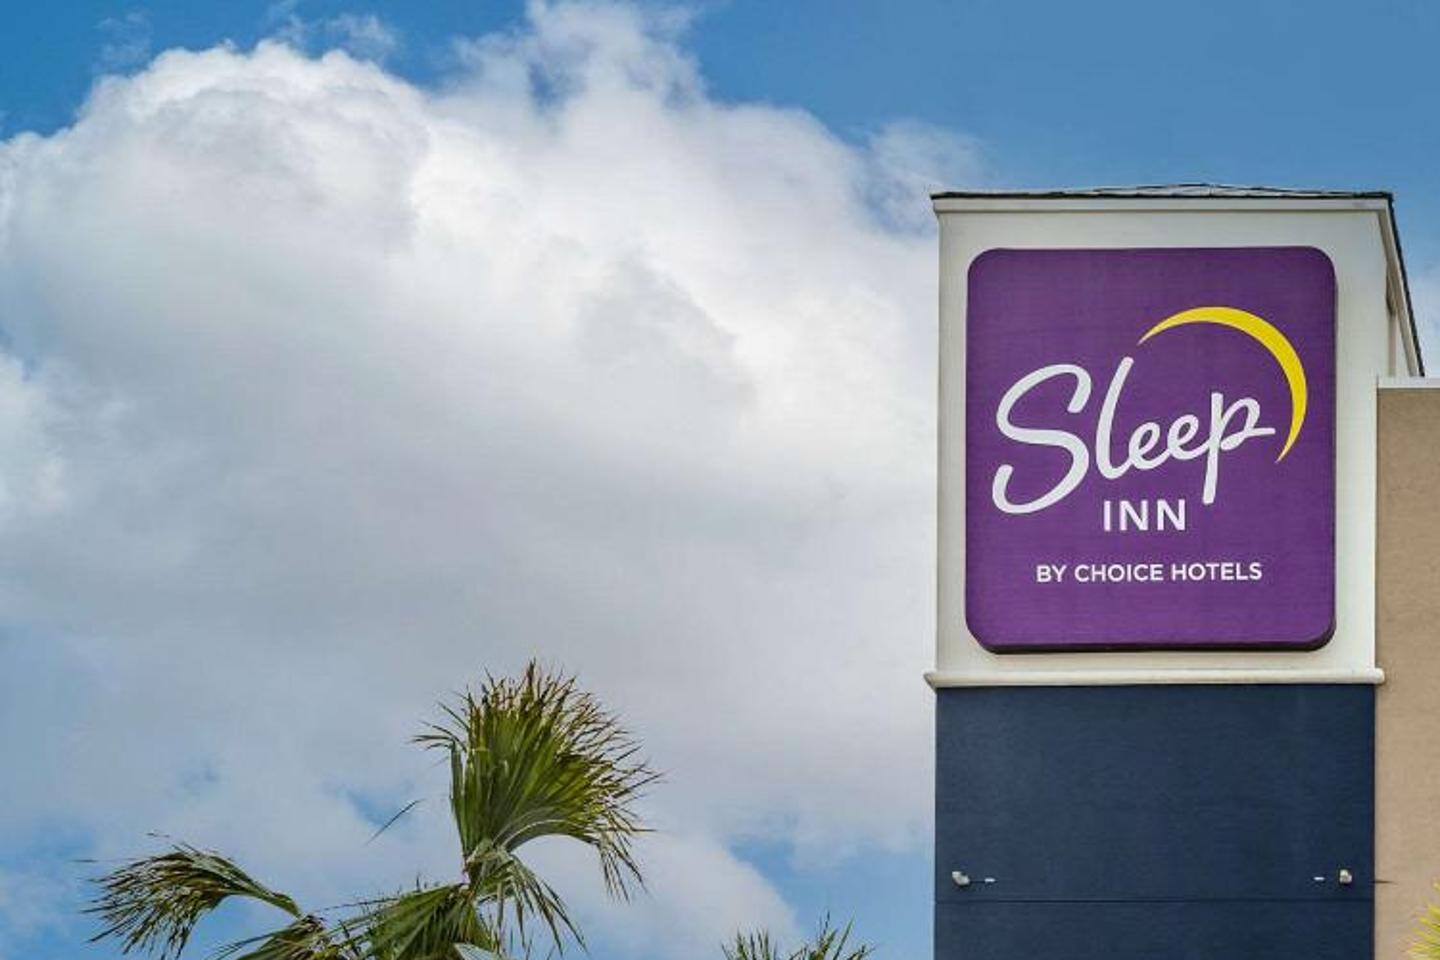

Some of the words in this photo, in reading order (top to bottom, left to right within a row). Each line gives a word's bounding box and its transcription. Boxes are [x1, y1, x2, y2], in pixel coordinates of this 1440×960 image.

[992, 356, 1276, 514] Sleep
[1103, 499, 1187, 532] INN
[1036, 564, 1067, 583] BY
[1074, 563, 1164, 582] CHOICE
[1171, 561, 1262, 581] HOTELS
